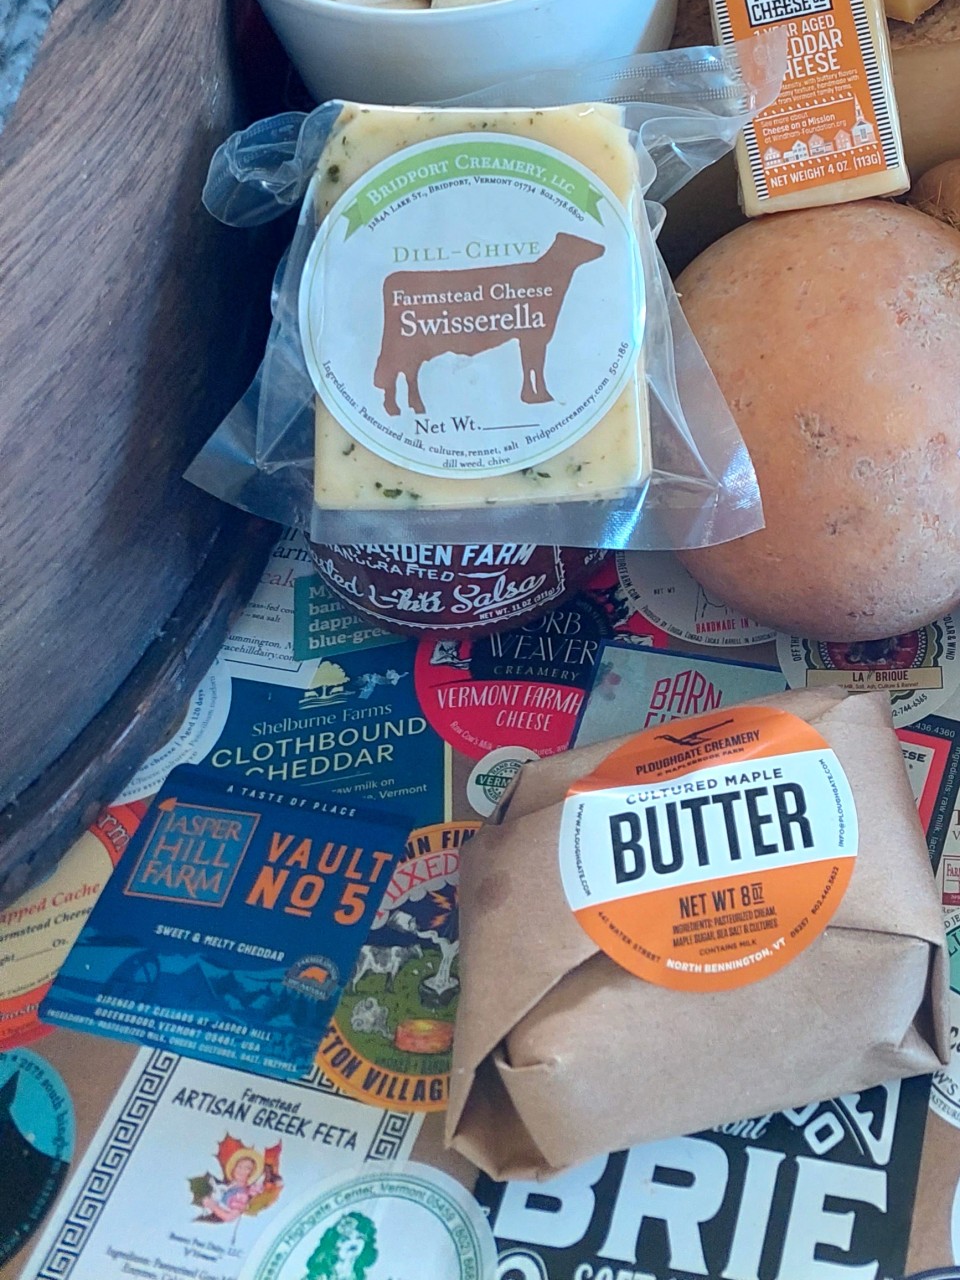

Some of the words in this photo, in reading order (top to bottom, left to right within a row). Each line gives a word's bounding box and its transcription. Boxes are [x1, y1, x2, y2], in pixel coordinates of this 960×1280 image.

[801, 14, 835, 34] AGED
[366, 160, 450, 205] BRIDPORT
[453, 154, 548, 181] CREAMERY,
[551, 174, 576, 195] LLC
[392, 241, 540, 263] DILL-CHIVE
[392, 286, 484, 307] Farmstead
[489, 283, 553, 301] Cheese
[400, 304, 546, 338] Swisserella
[608, 341, 629, 376] 50-186
[414, 419, 446, 434] Net
[451, 417, 482, 432] Wt.
[488, 636, 598, 667] WEAVER
[852, 671, 864, 682] LA
[875, 670, 909, 682] BRIQUE
[437, 689, 520, 711] VERMONT
[496, 710, 551, 732] CHEESE
[210, 717, 428, 770] CLOTHBOUND
[626, 778, 718, 805] CULTURED
[725, 768, 783, 786] MAPLE
[609, 782, 814, 885] BUTTER
[267, 832, 393, 879] VAULT
[171, 1087, 250, 1124] ARTISAN
[251, 1110, 309, 1138] GREEK
[312, 1123, 359, 1151] FETA
[493, 1136, 888, 1280] BRIE
